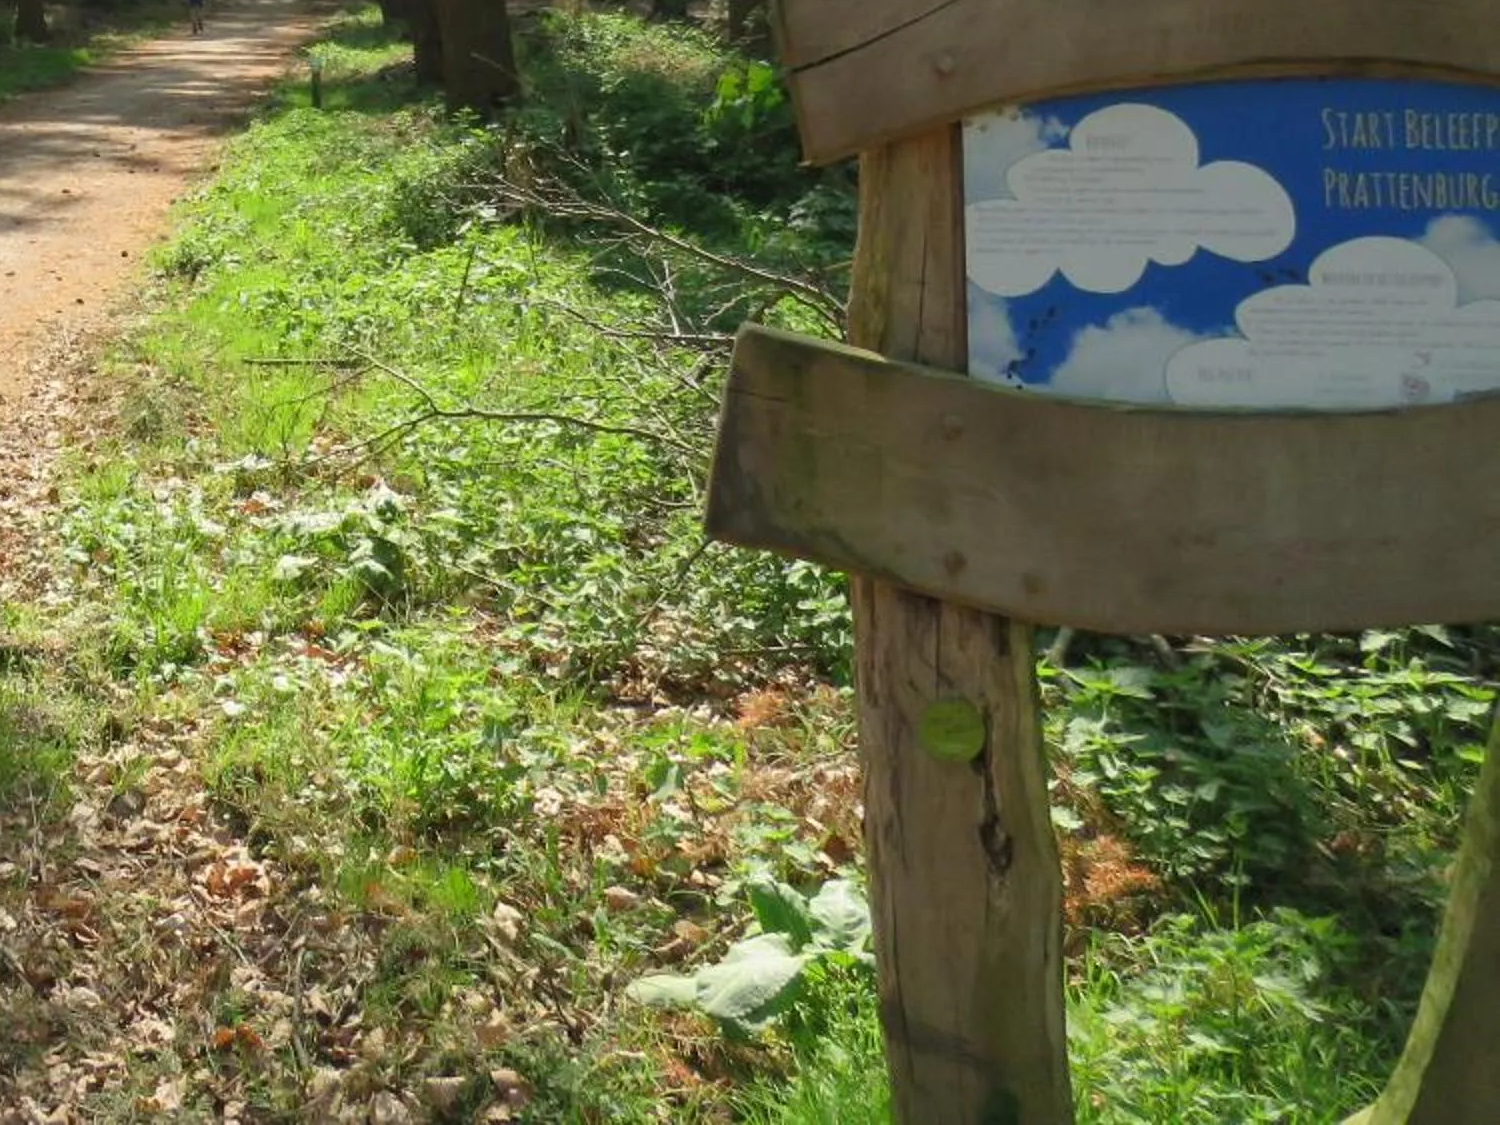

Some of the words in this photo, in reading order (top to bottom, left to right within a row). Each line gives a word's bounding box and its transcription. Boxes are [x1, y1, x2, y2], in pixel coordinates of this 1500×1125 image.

[1321, 107, 1395, 150] START
[1404, 108, 1500, 150] BELEEFP
[1323, 166, 1500, 210] PRATTENBURG
